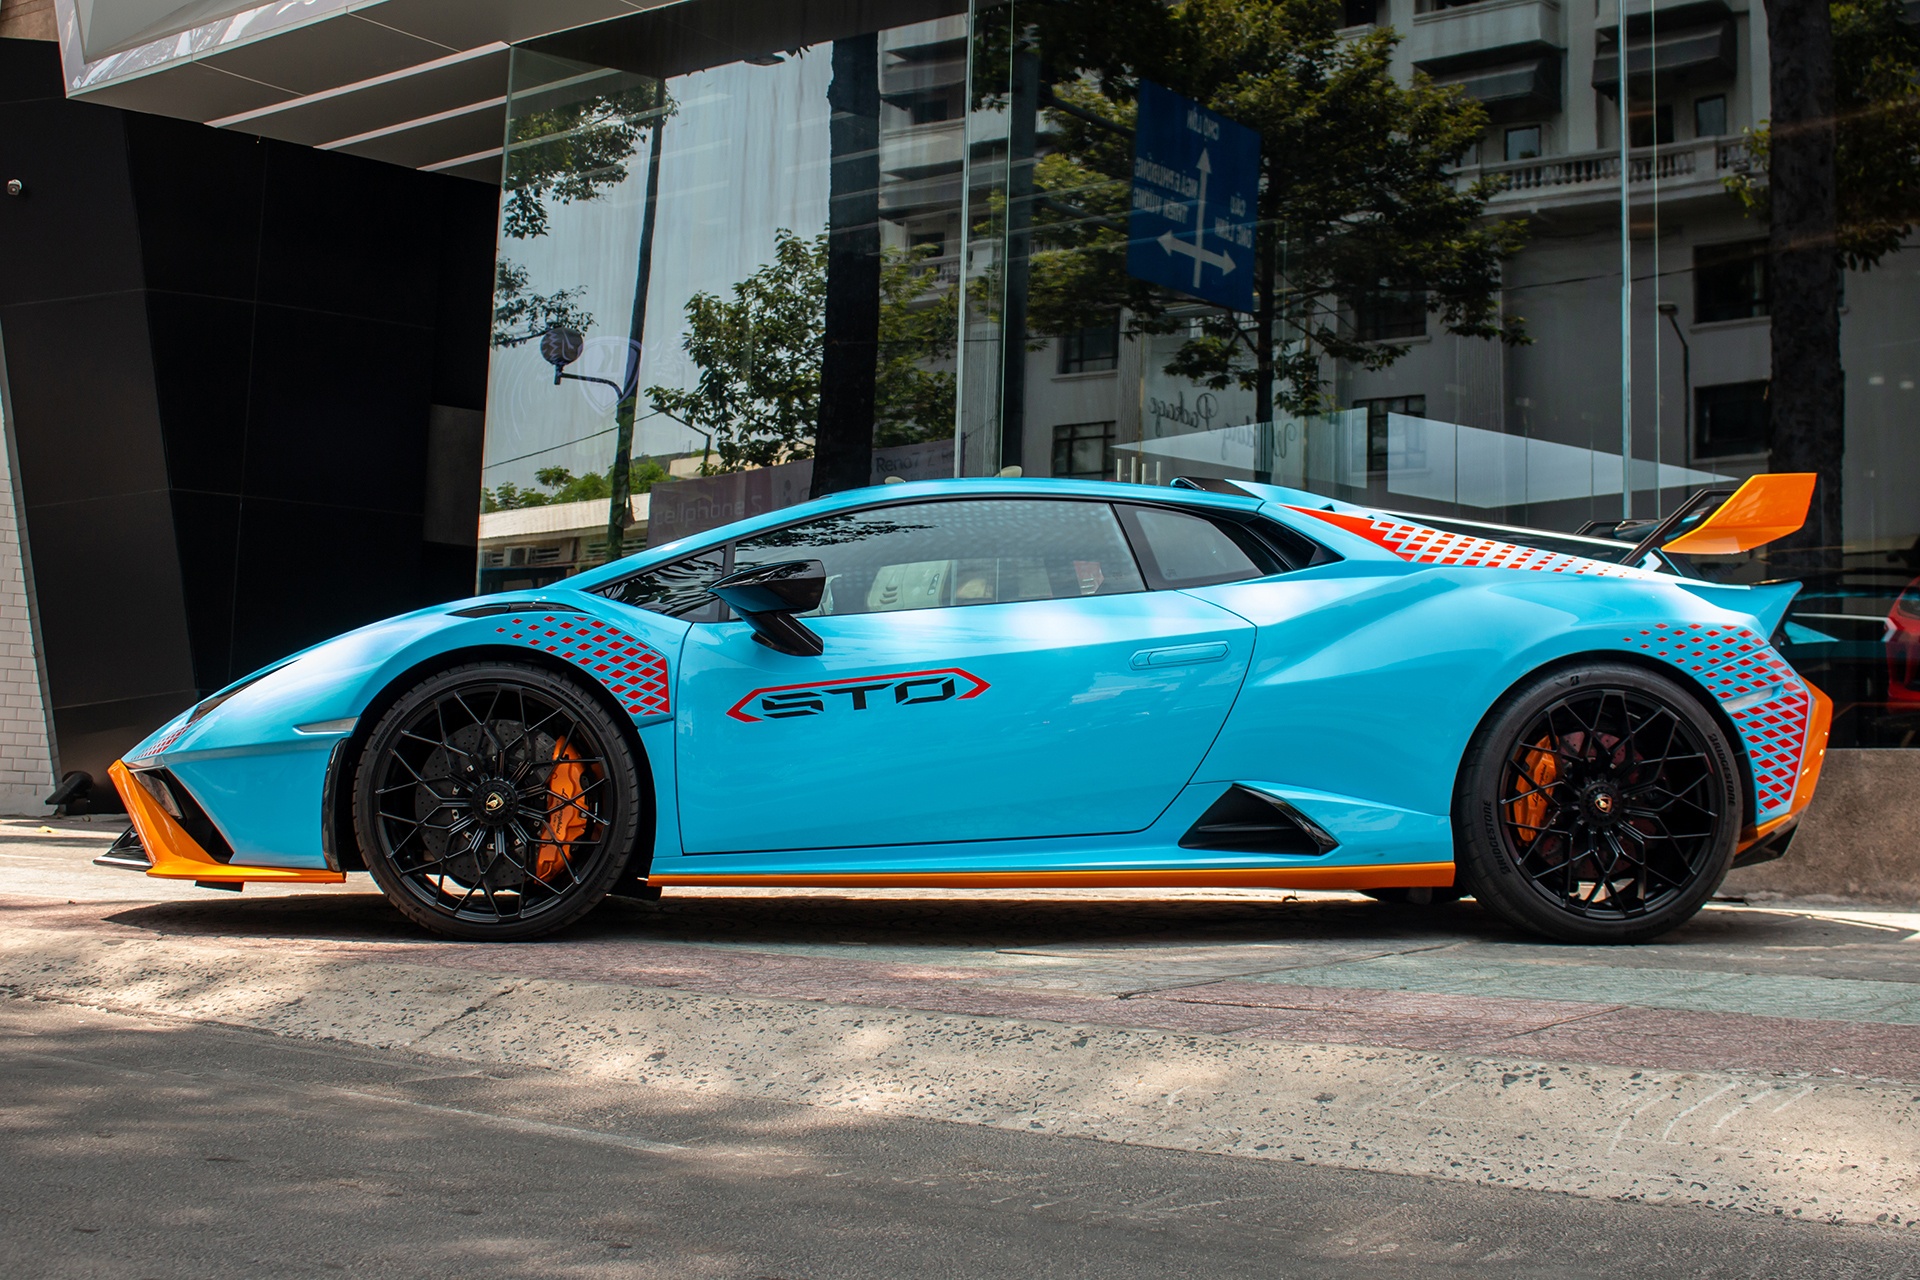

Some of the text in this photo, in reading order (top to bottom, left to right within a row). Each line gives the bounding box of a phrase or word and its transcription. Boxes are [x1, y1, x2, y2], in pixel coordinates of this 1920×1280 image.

[549, 684, 584, 710] POTENZA
[761, 676, 956, 719] STO
[1707, 733, 1736, 807] BRIDGESTONE
[1483, 800, 1513, 875] BRIDGESTONE
